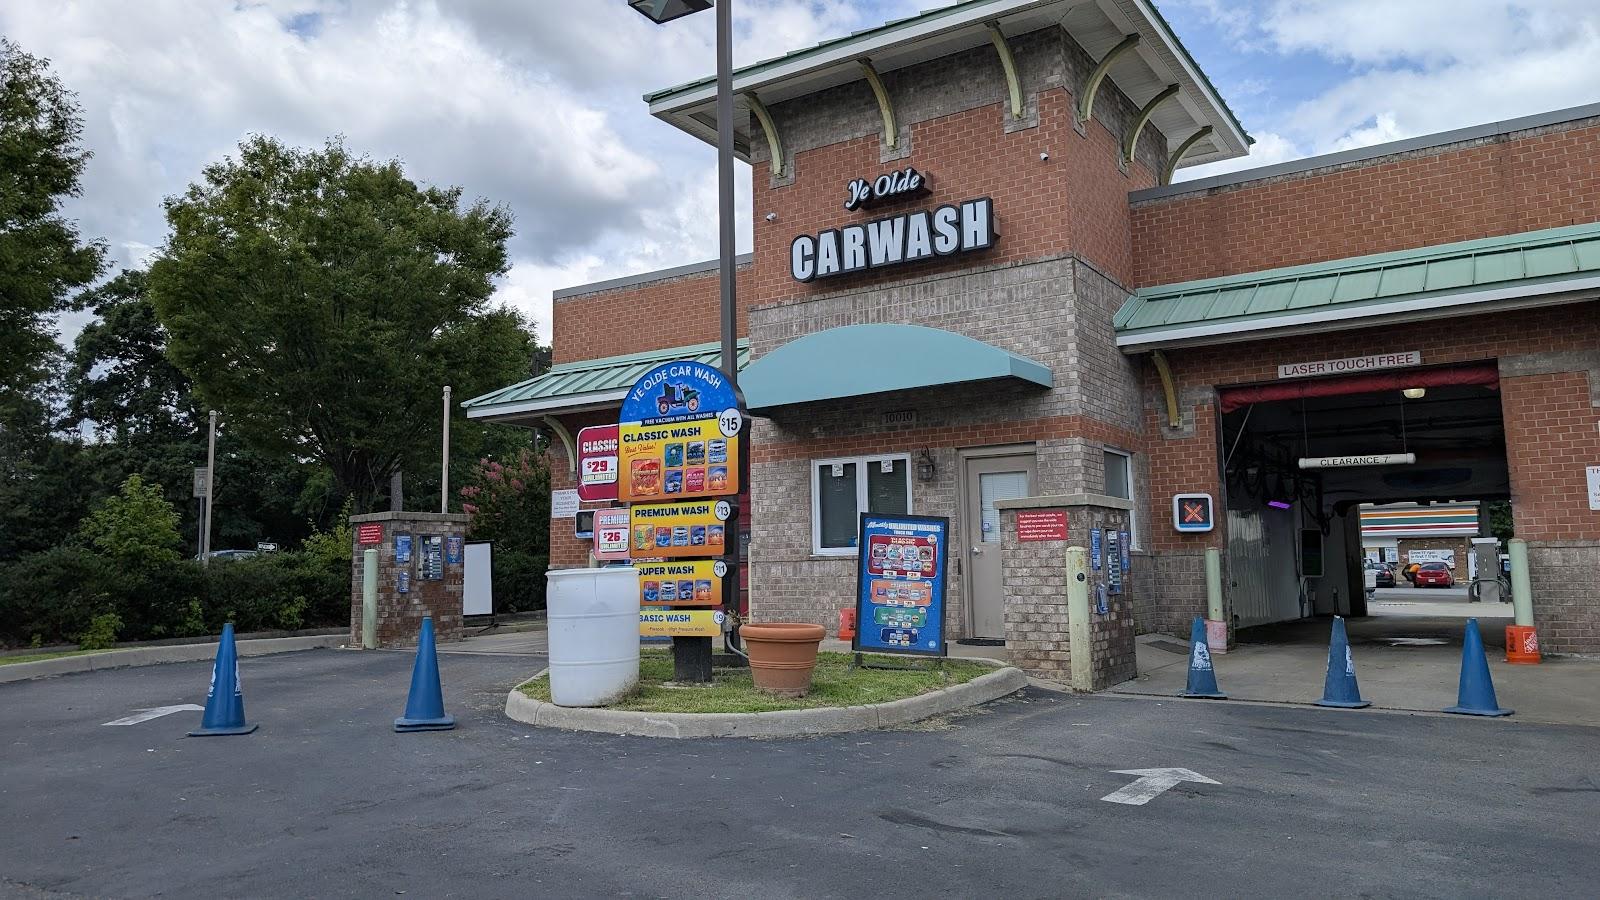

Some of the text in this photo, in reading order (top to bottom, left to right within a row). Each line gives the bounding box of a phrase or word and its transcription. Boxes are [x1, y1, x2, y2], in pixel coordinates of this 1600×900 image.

[845, 168, 920, 209] Ye Olde
[792, 200, 988, 280] CARWASH
[1284, 354, 1414, 376] LASER TOUCH FREE
[631, 365, 722, 402] YE OLDE CAR WASH
[721, 416, 738, 431] $15
[884, 412, 913, 423] 10010
[623, 426, 702, 443] CLASSIC WASH
[582, 438, 619, 454] CLASSIC
[624, 442, 658, 454] Best Value!
[586, 460, 608, 473] $29
[1320, 455, 1380, 466] CLEARANCE
[583, 472, 617, 482] UNLIMITED
[634, 505, 710, 518] PREMIUM WASH
[716, 506, 729, 516] $13
[603, 532, 620, 542] $26
[638, 566, 694, 576] SUPER WASH
[716, 565, 726, 574] $11
[666, 614, 691, 622] WASH
